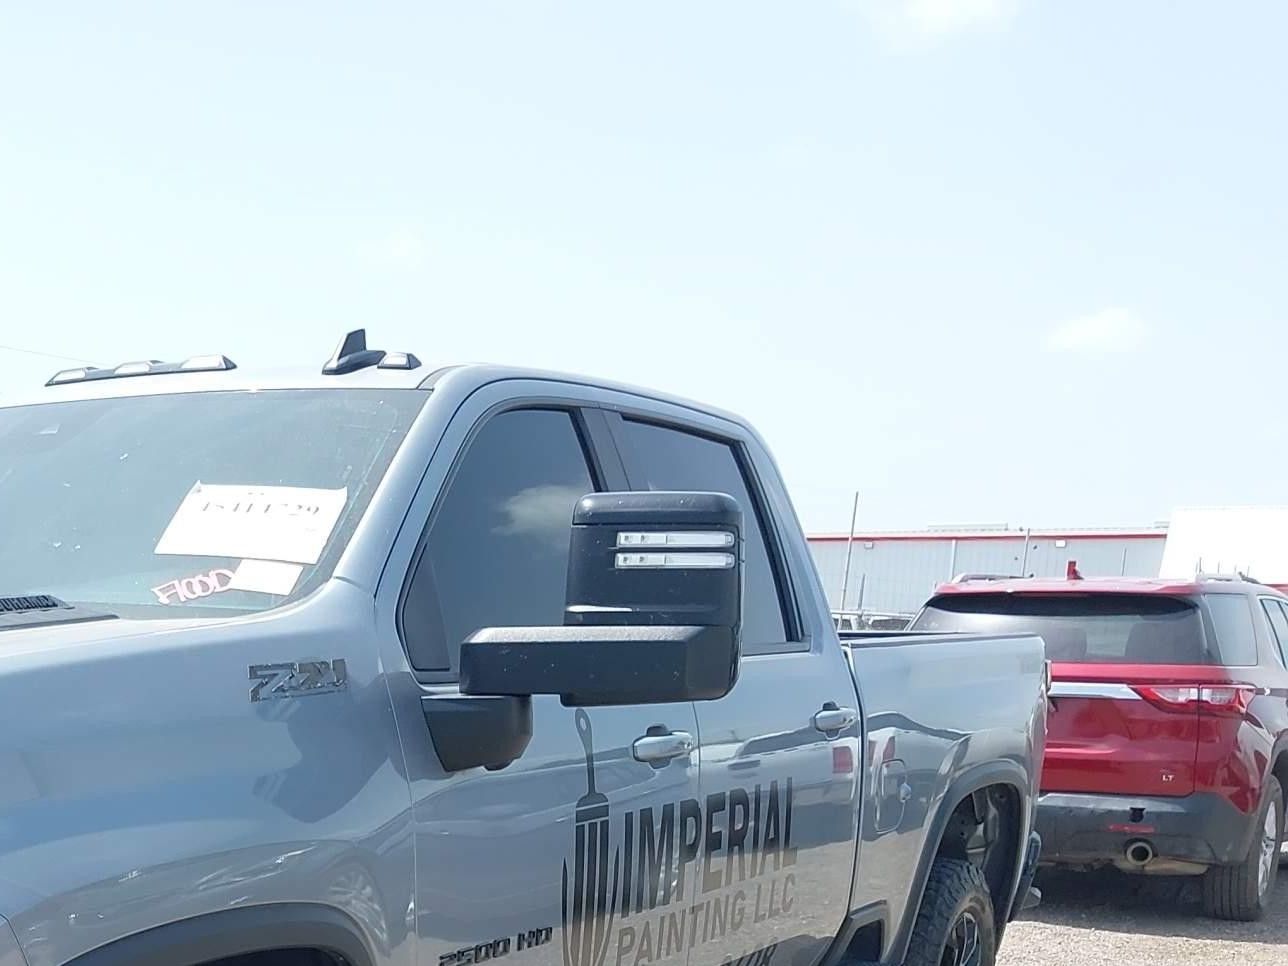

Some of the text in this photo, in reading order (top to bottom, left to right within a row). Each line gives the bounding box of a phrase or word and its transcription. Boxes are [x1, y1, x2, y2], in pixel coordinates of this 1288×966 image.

[1161, 774, 1176, 782] LT
[621, 777, 798, 919] IMPERIAL
[753, 873, 796, 924] LLC
[516, 926, 553, 952] HD
